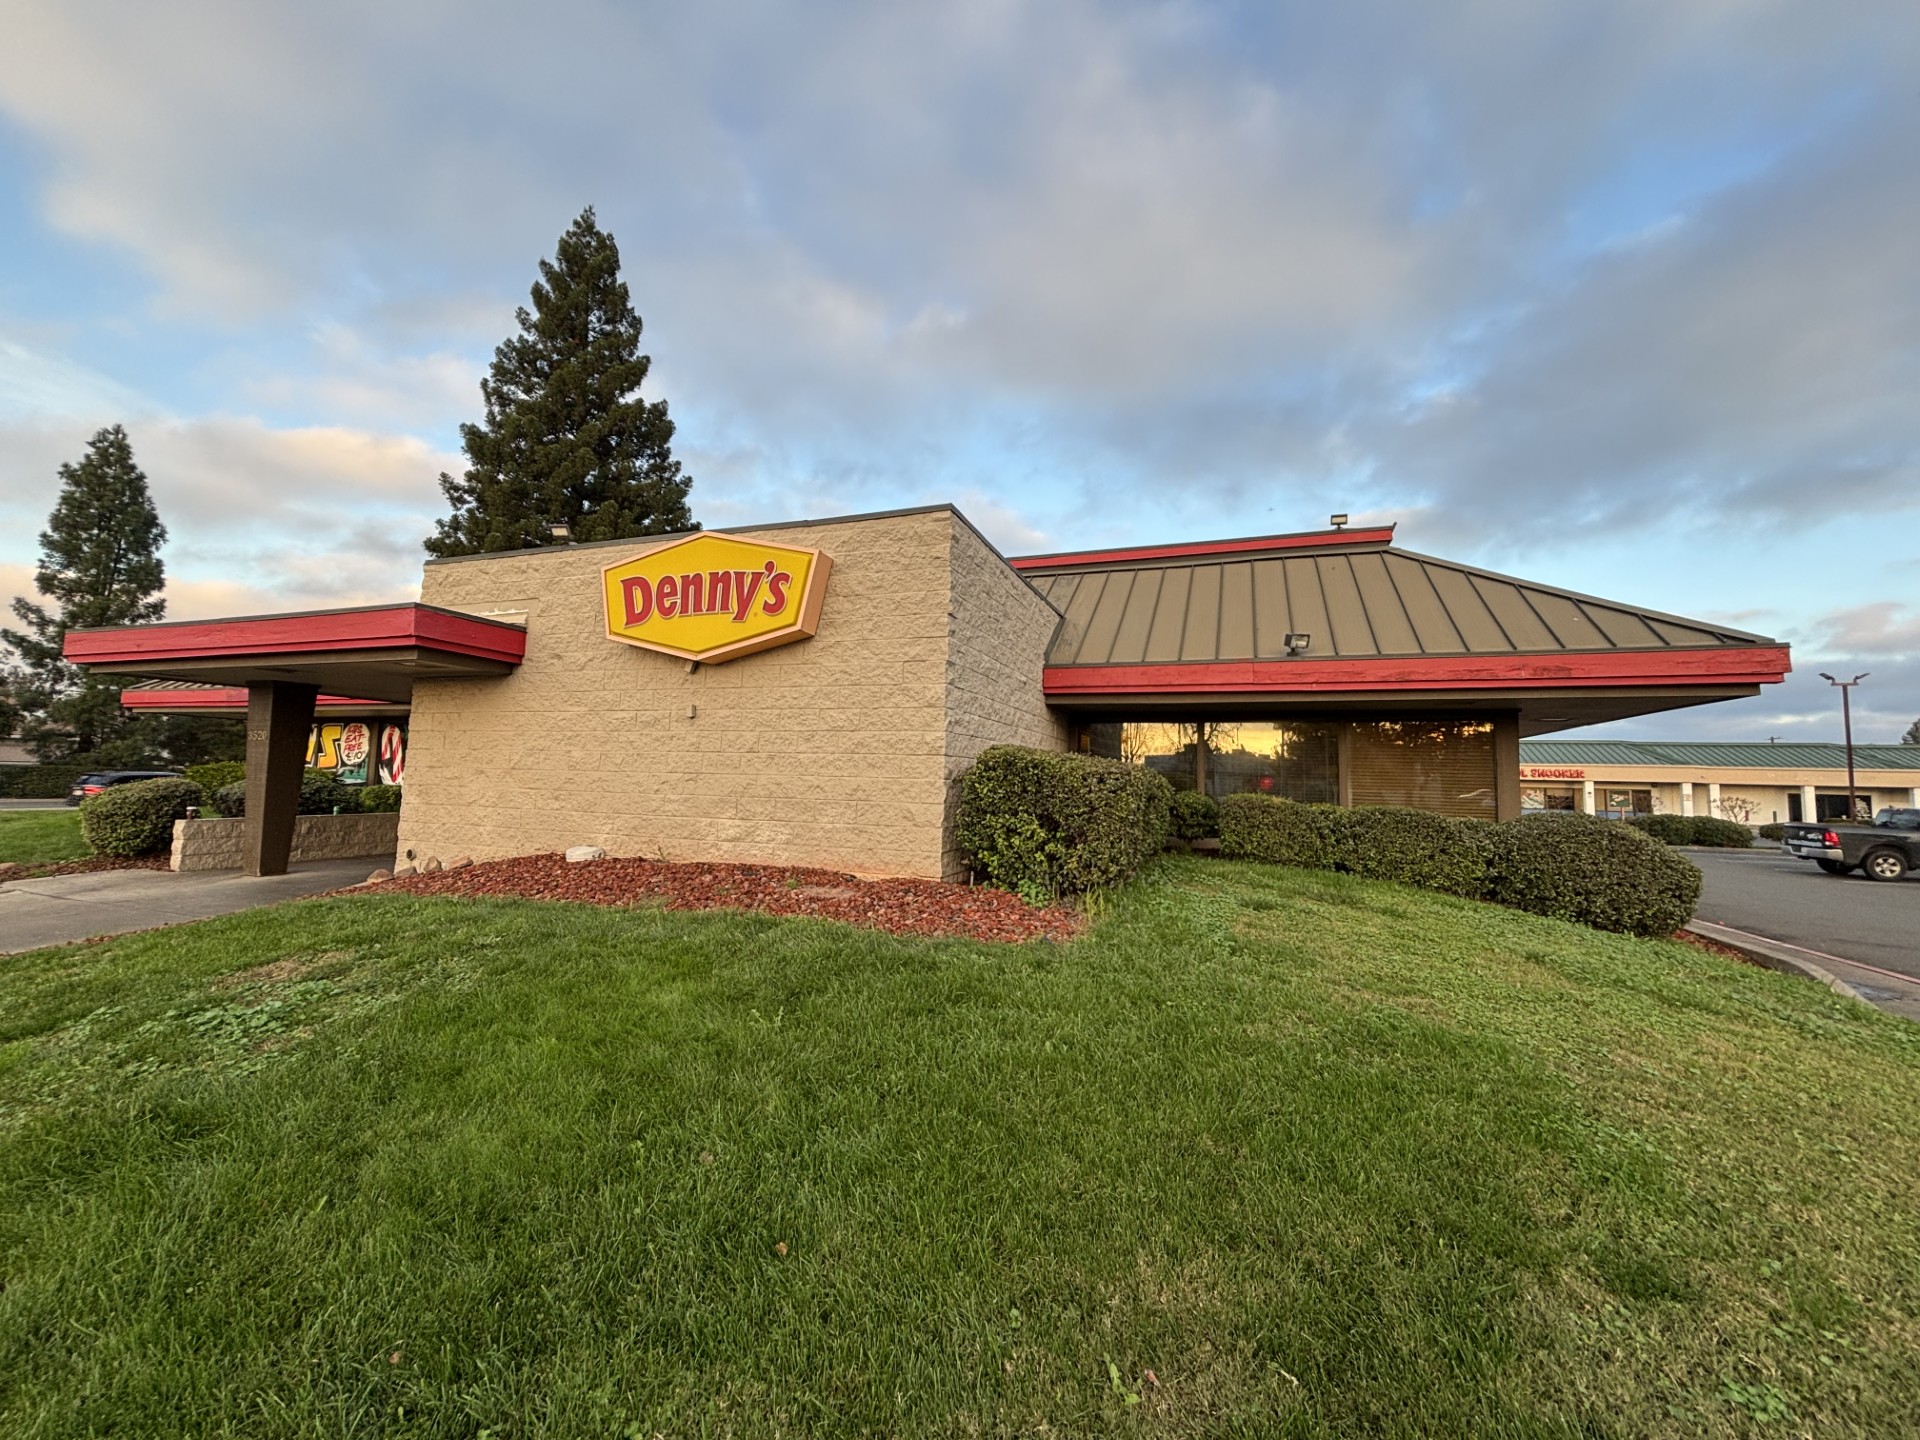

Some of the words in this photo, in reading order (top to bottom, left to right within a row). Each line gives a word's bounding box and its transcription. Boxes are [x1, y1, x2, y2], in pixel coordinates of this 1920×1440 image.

[619, 560, 793, 629] Denny's
[248, 730, 267, 740] 3520
[1530, 769, 1585, 778] SNOOKER
